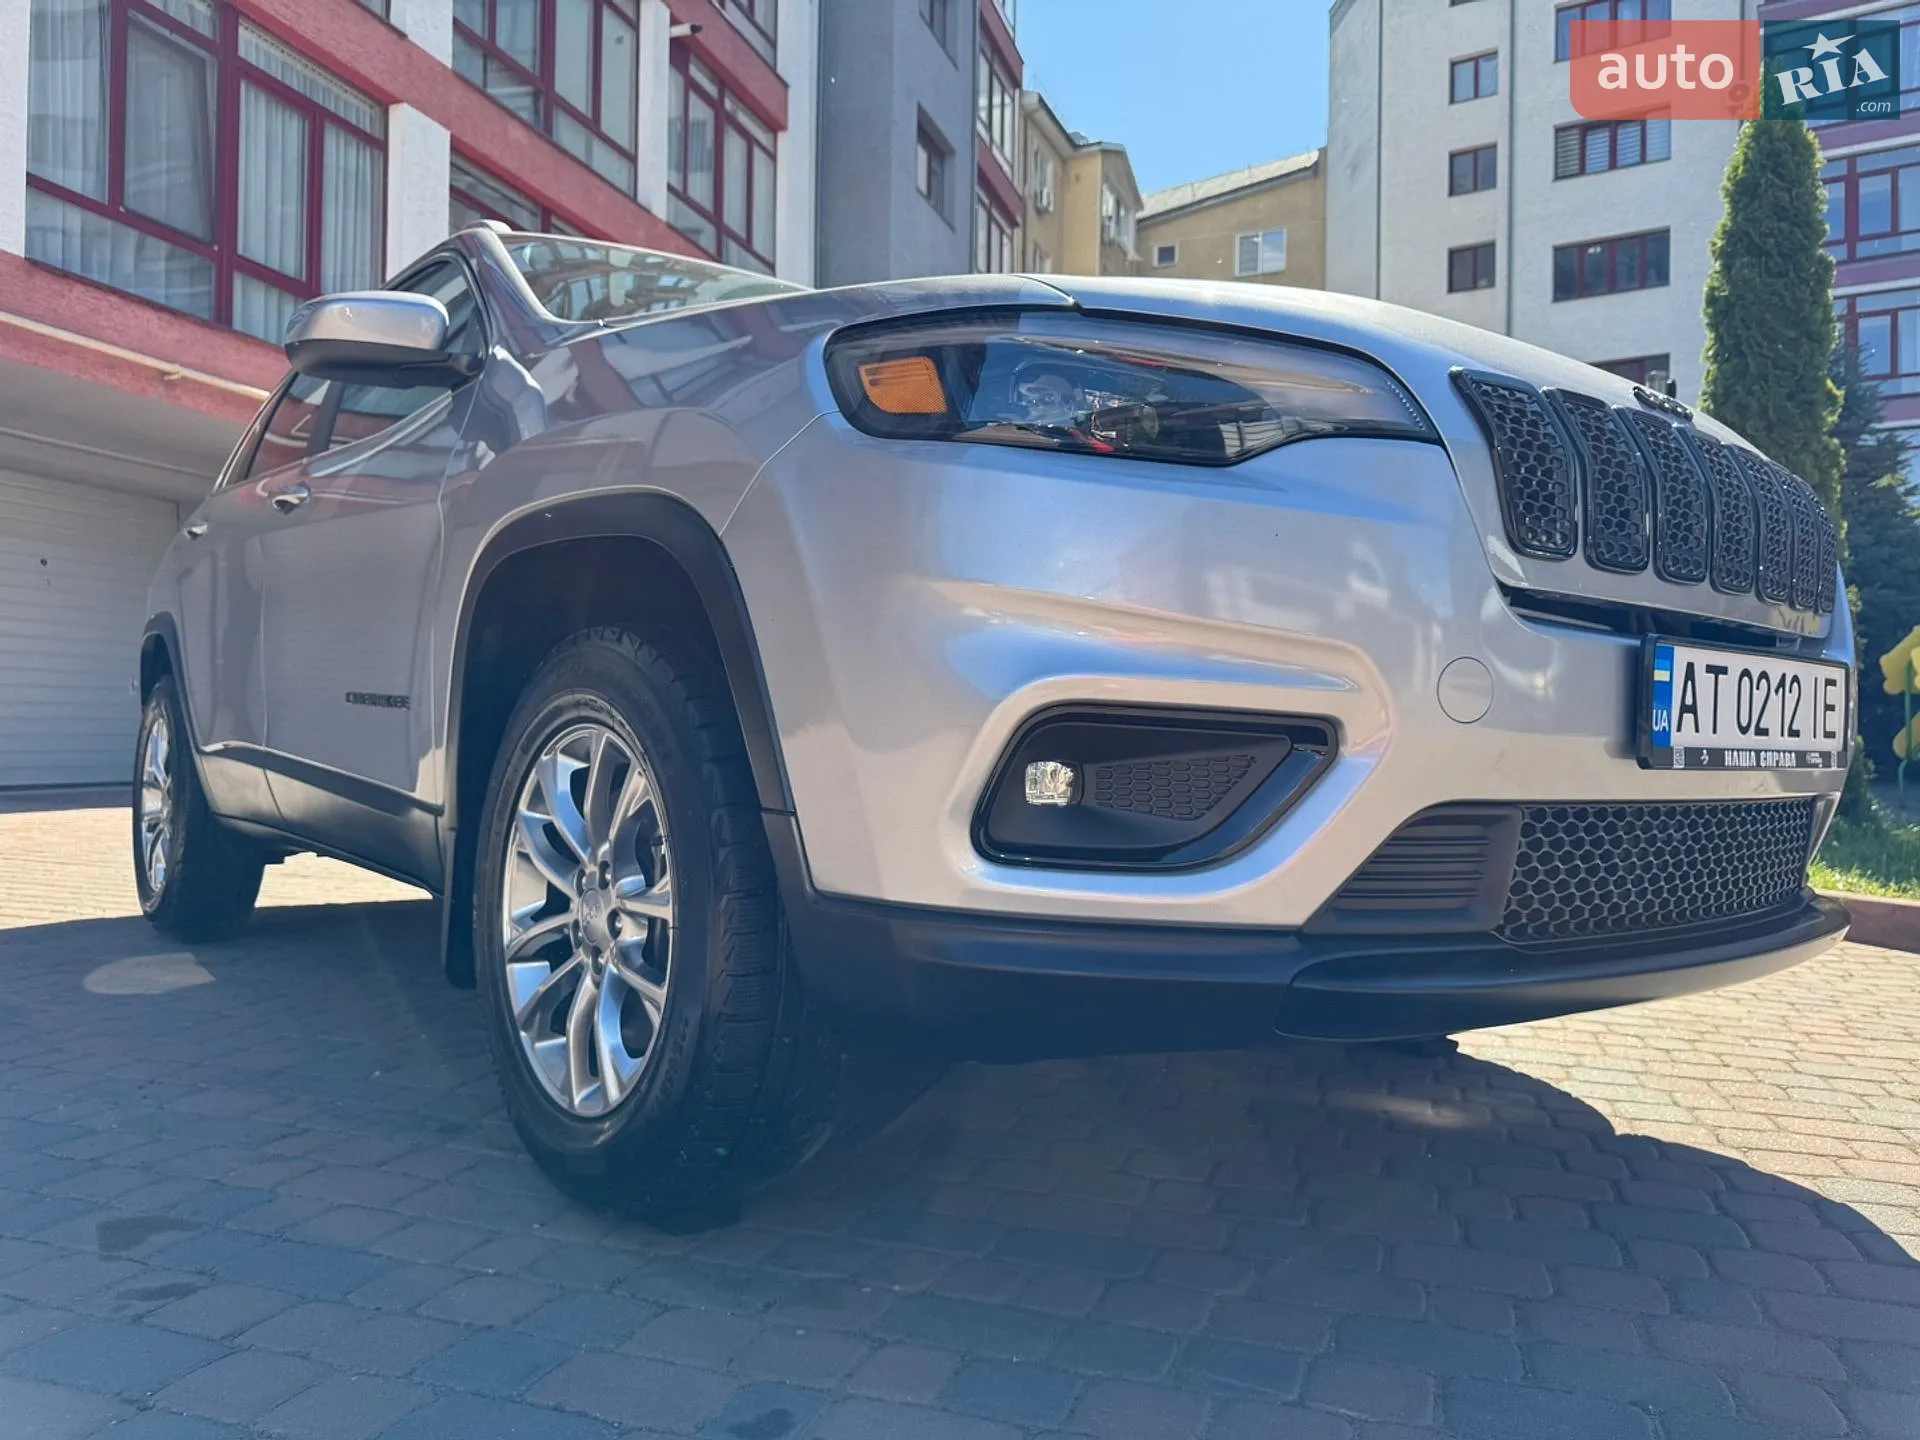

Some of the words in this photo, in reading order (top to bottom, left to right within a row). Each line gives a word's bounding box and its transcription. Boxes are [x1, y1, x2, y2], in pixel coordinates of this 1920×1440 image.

[1676, 661, 1728, 735] AT
[1736, 668, 1802, 738] 0212
[1813, 676, 1837, 739] IE
[1652, 709, 1669, 732] UA
[1724, 749, 1756, 768] НАША
